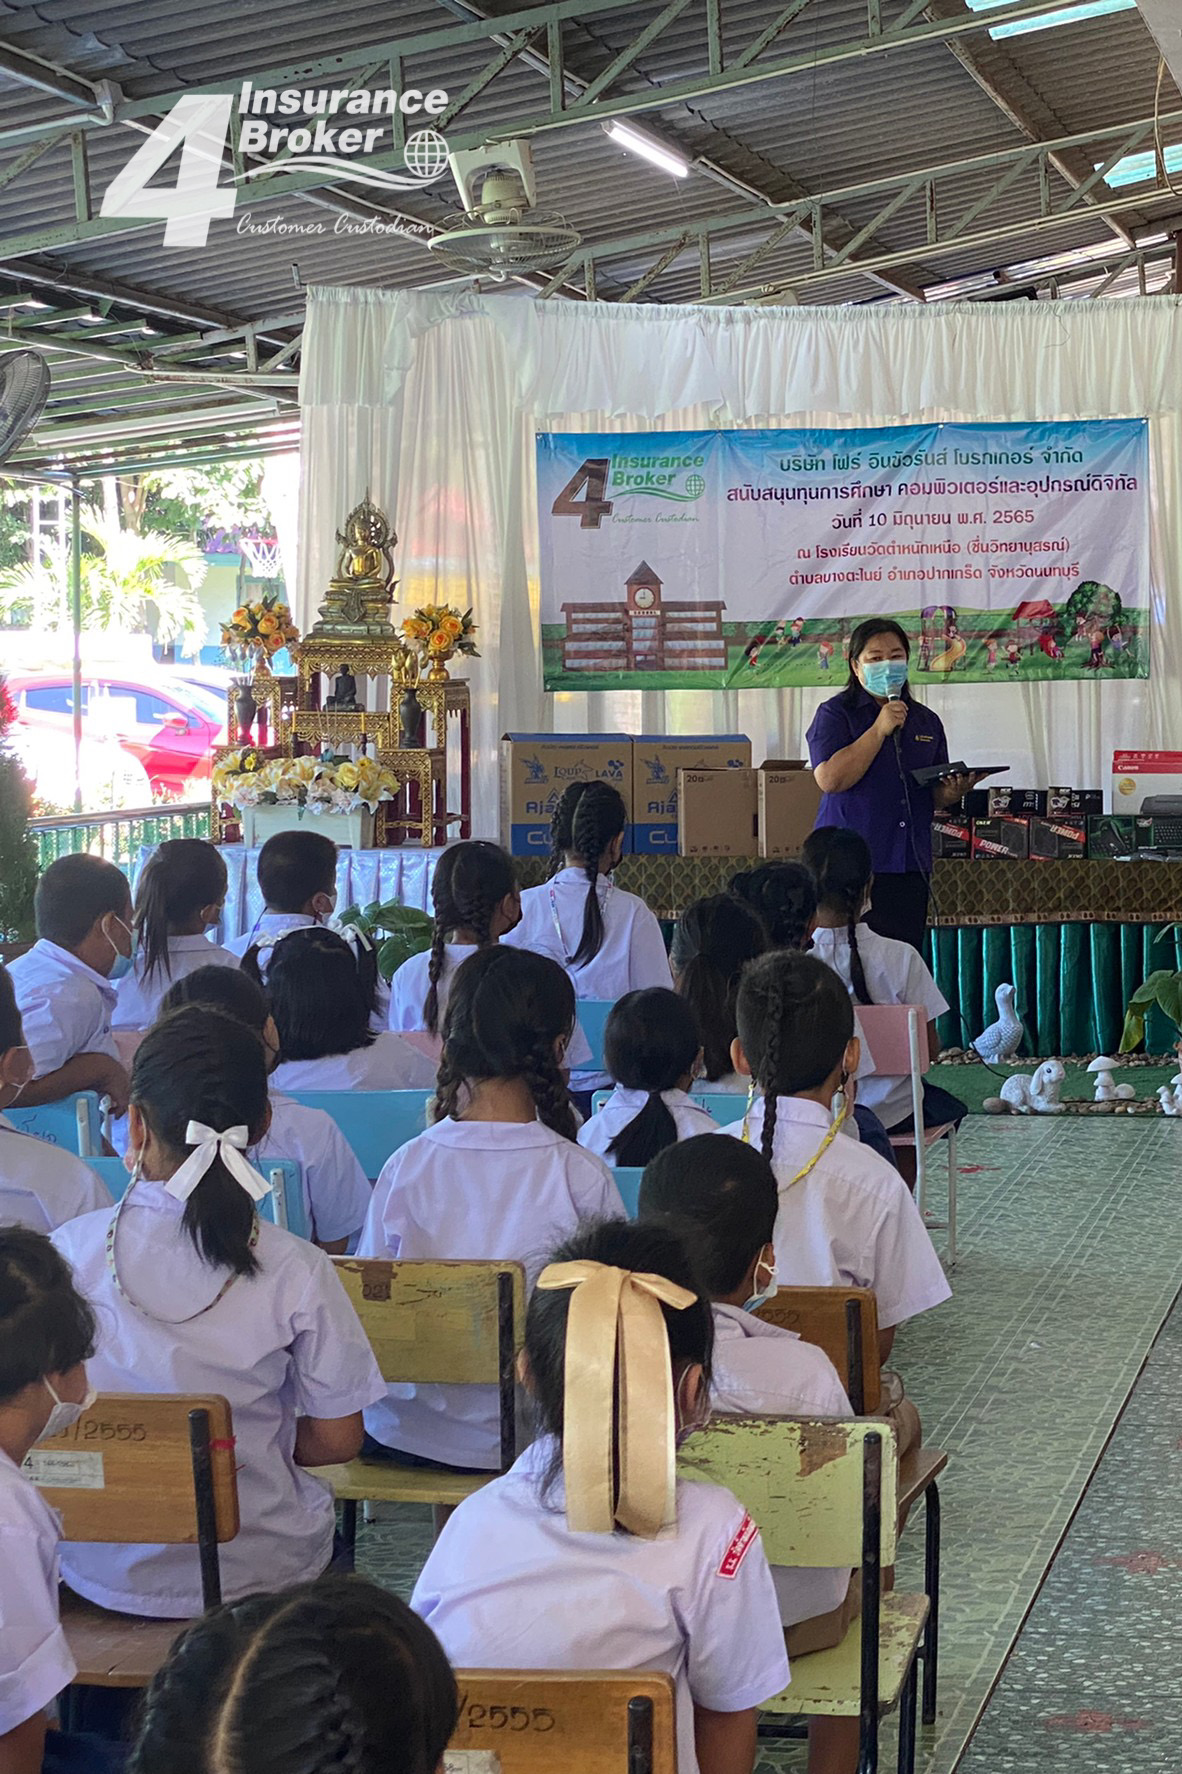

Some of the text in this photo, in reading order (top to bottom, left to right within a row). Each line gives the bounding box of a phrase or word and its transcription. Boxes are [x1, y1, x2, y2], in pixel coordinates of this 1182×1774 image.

[611, 453, 704, 468] Insurance
[780, 453, 825, 471] บริษัท
[833, 452, 861, 470] โฟร์
[954, 446, 1034, 465] โบรกเกอร์
[1043, 446, 1083, 464] จำกัด
[611, 471, 676, 486] Broker
[727, 473, 1137, 505] สนับสนุนทุนการศึกษา คอมพิวเตอร์และอุปกรณ์ดิจิทัล
[551, 458, 614, 529] 4
[612, 512, 699, 523] Customer Custodian
[832, 509, 862, 529] วันที่
[869, 513, 887, 527] 10
[892, 511, 951, 530] มิถุนายน
[993, 510, 1035, 523] 2565
[816, 538, 961, 559] โรงเรียนวัดตำหนักเหนือ
[888, 564, 983, 582] อำเภอปากเกร็ด
[989, 561, 1080, 581] จังหวัดนนทบุรี
[595, 769, 623, 778] LAVA
[979, 839, 1009, 855] POWER
